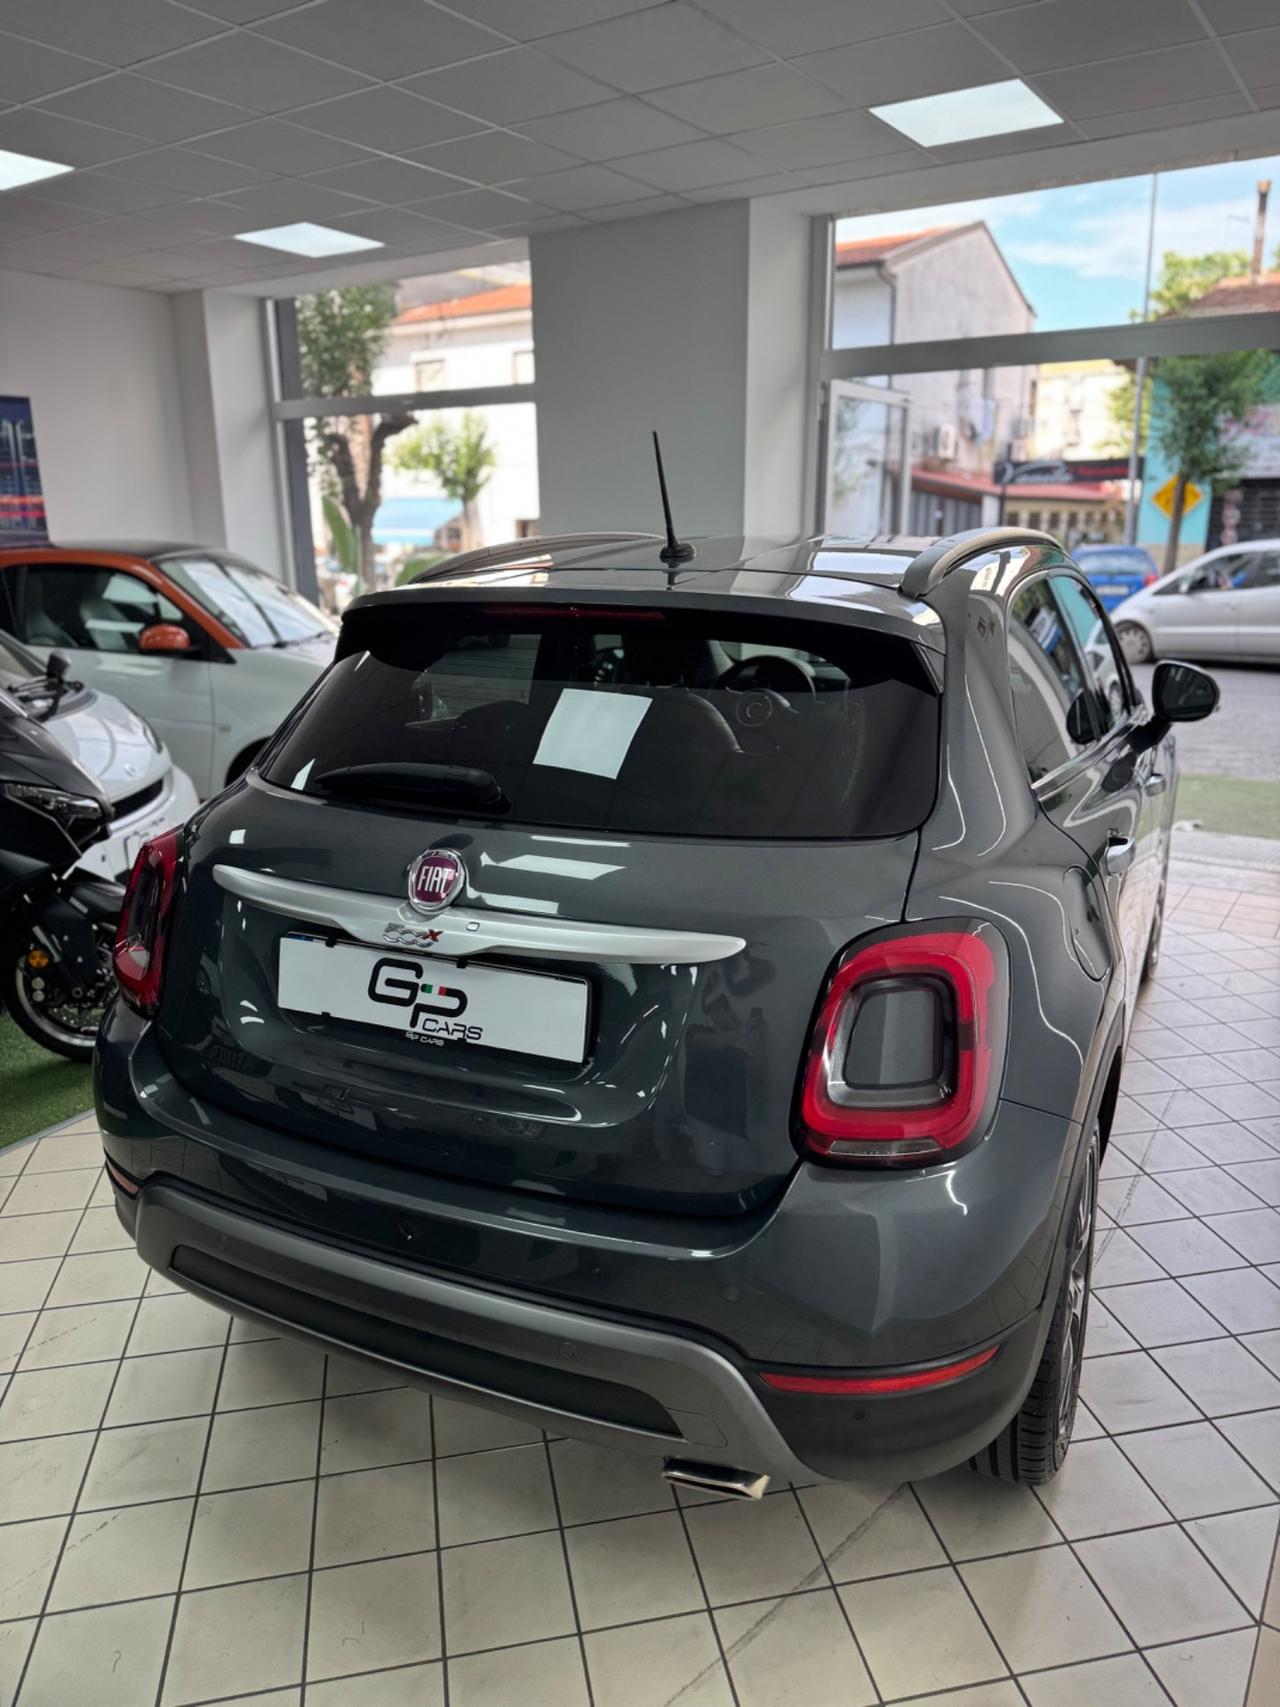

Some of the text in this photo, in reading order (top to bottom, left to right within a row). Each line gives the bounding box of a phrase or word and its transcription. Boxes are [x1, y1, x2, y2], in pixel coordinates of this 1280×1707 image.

[417, 866, 456, 893] FIAT
[367, 957, 468, 1029] GP
[420, 1034, 444, 1046] CARS
[422, 1018, 483, 1041] CARS
